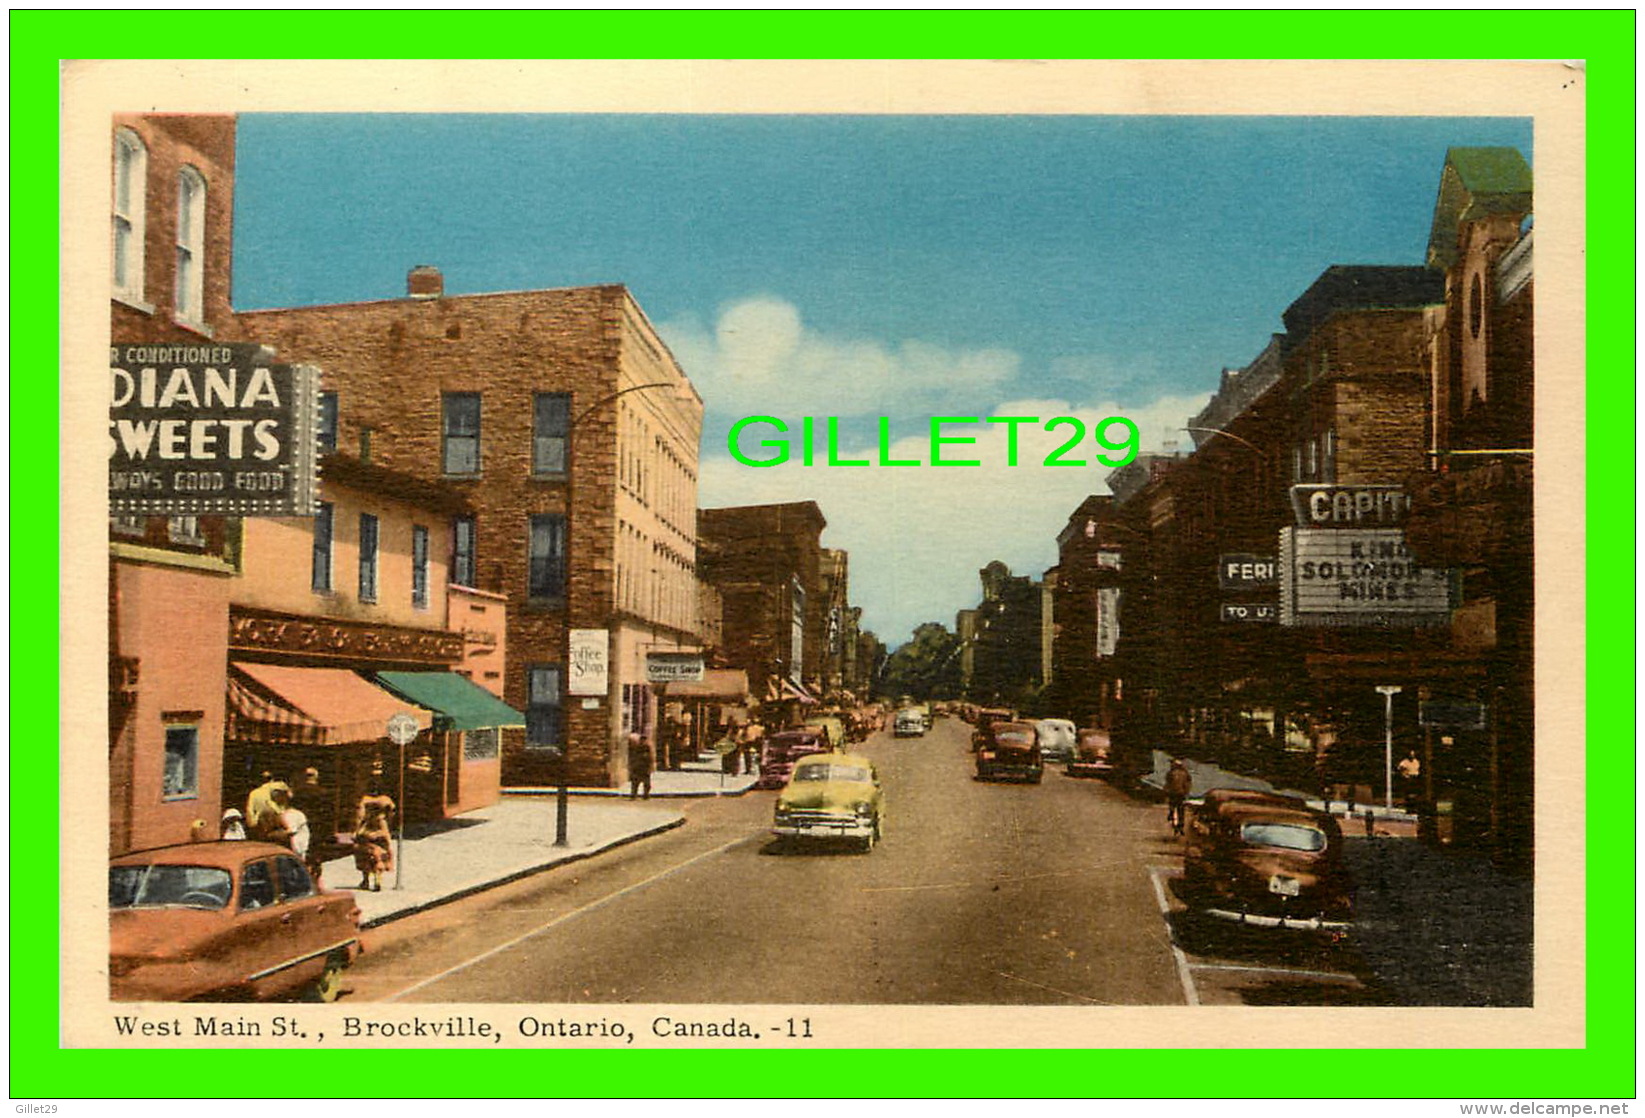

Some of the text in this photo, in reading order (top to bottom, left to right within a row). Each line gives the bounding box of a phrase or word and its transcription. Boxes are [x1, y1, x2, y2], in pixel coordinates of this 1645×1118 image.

[126, 347, 232, 363] CONDITIONED
[110, 367, 281, 409] DIANA
[173, 471, 225, 491] GOOD
[234, 471, 284, 491] FOOD
[1310, 490, 1411, 522] CAPIT
[1226, 606, 1248, 618] TO
[648, 664, 677, 674] COFFEE
